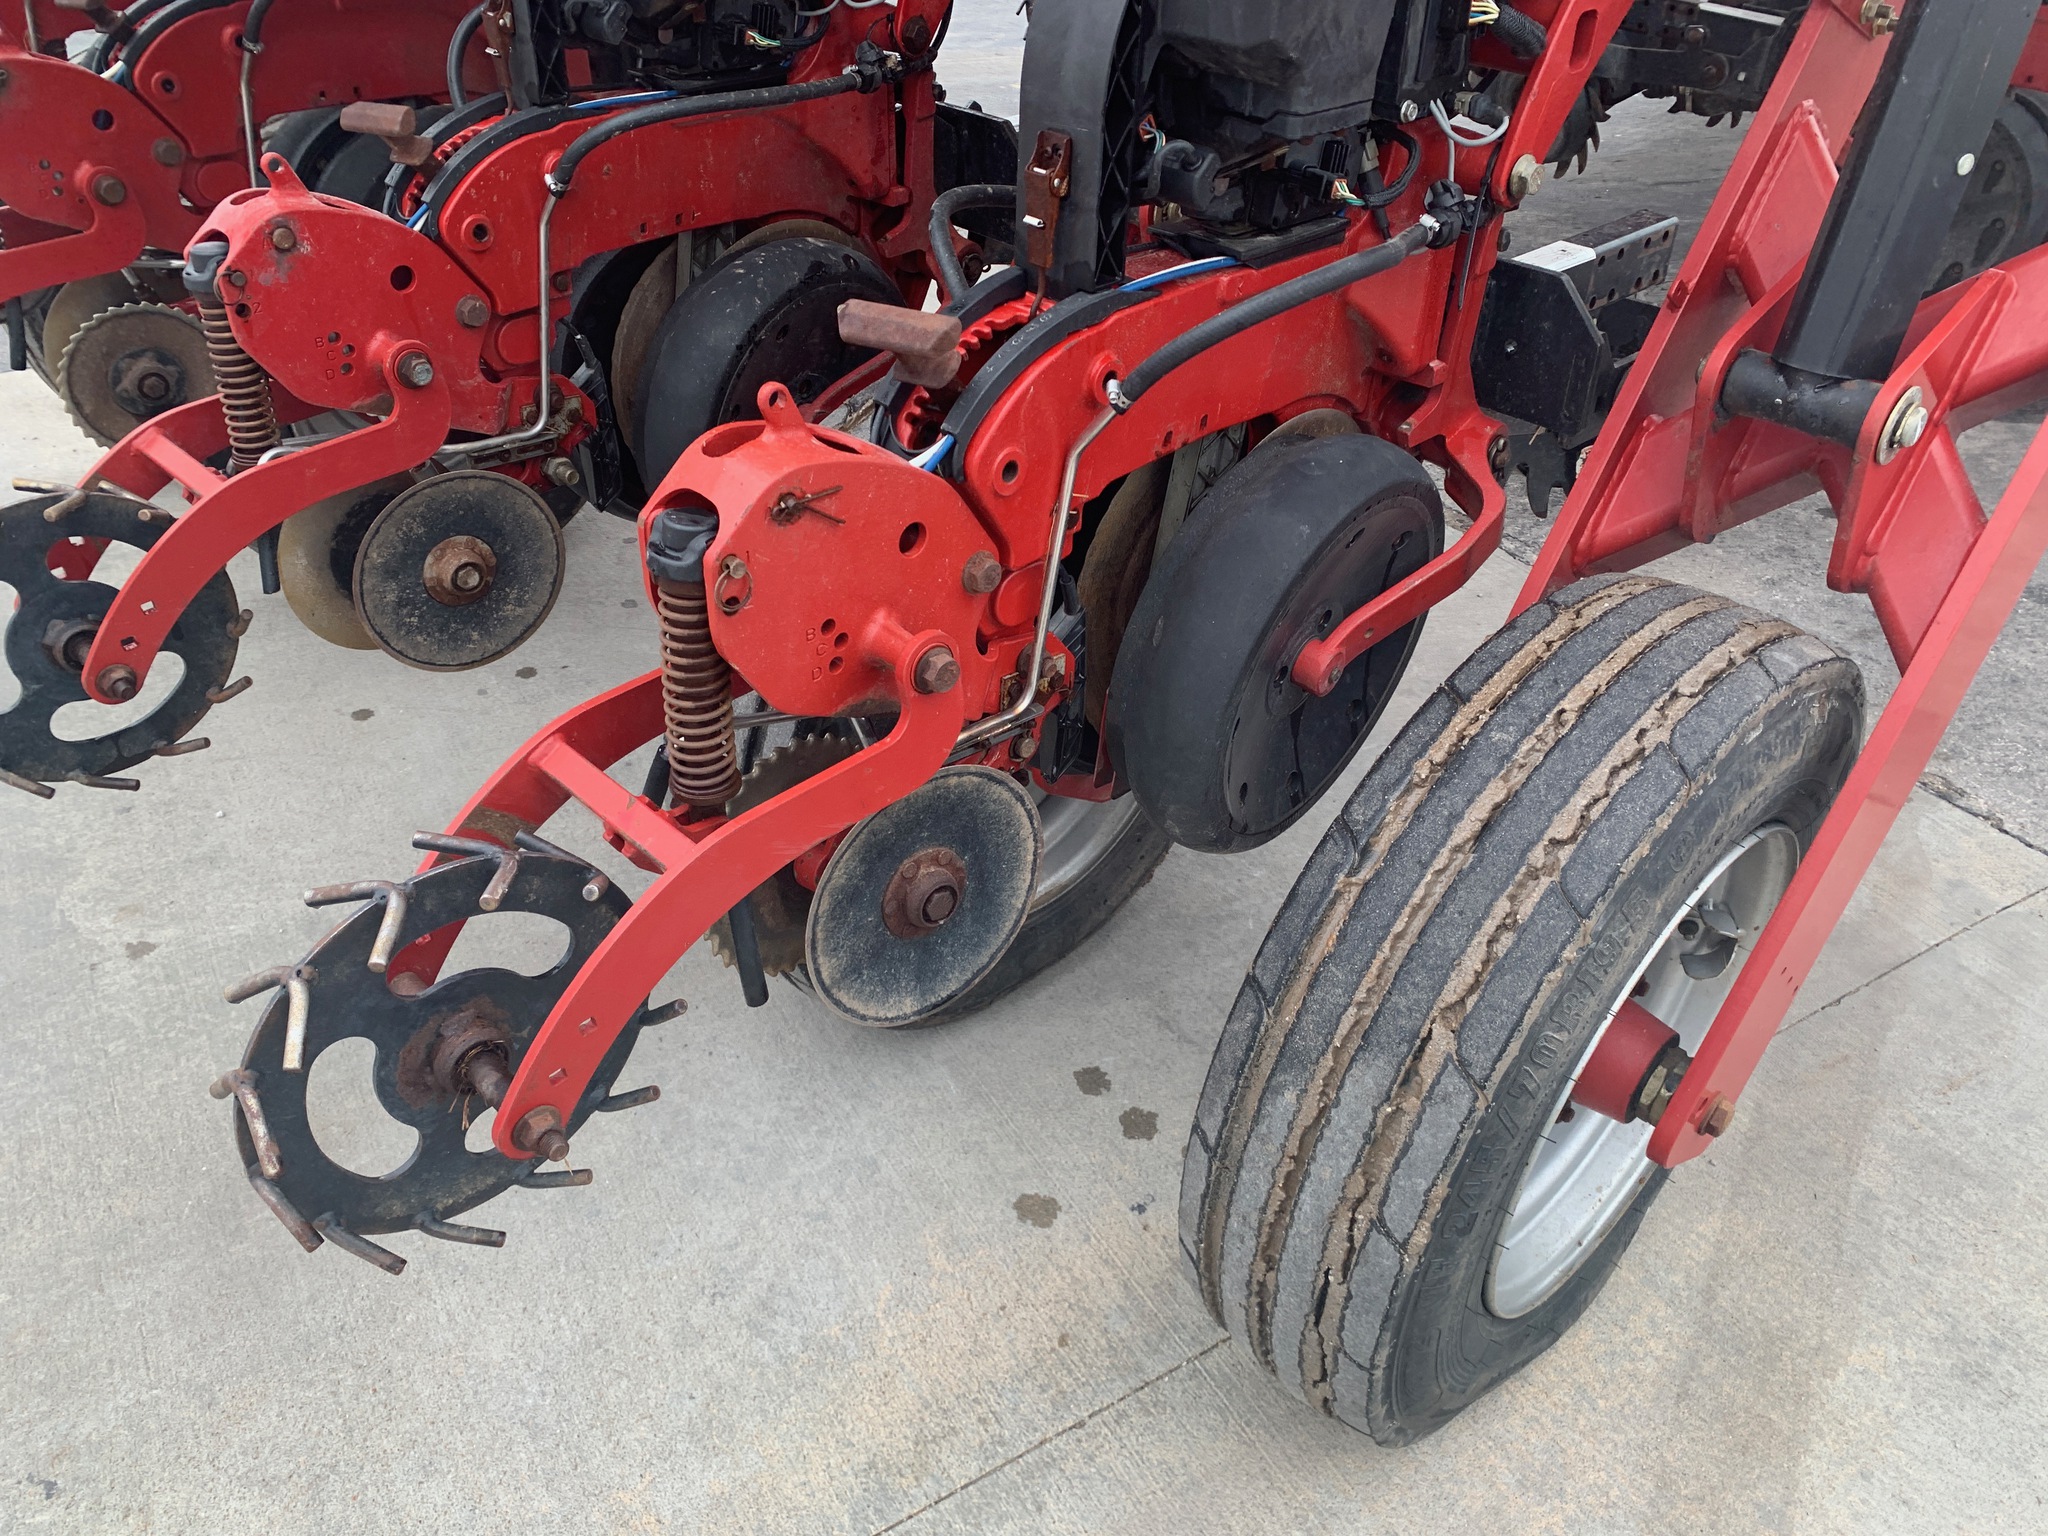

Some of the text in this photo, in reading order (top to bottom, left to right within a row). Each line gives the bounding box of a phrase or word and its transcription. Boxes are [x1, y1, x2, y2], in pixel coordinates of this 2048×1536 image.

[252, 301, 263, 315] 2
[315, 336, 325, 348] B
[326, 350, 337, 361] C
[325, 368, 336, 380] D
[806, 627, 816, 643] B
[816, 643, 828, 656] C
[812, 666, 823, 682] D
